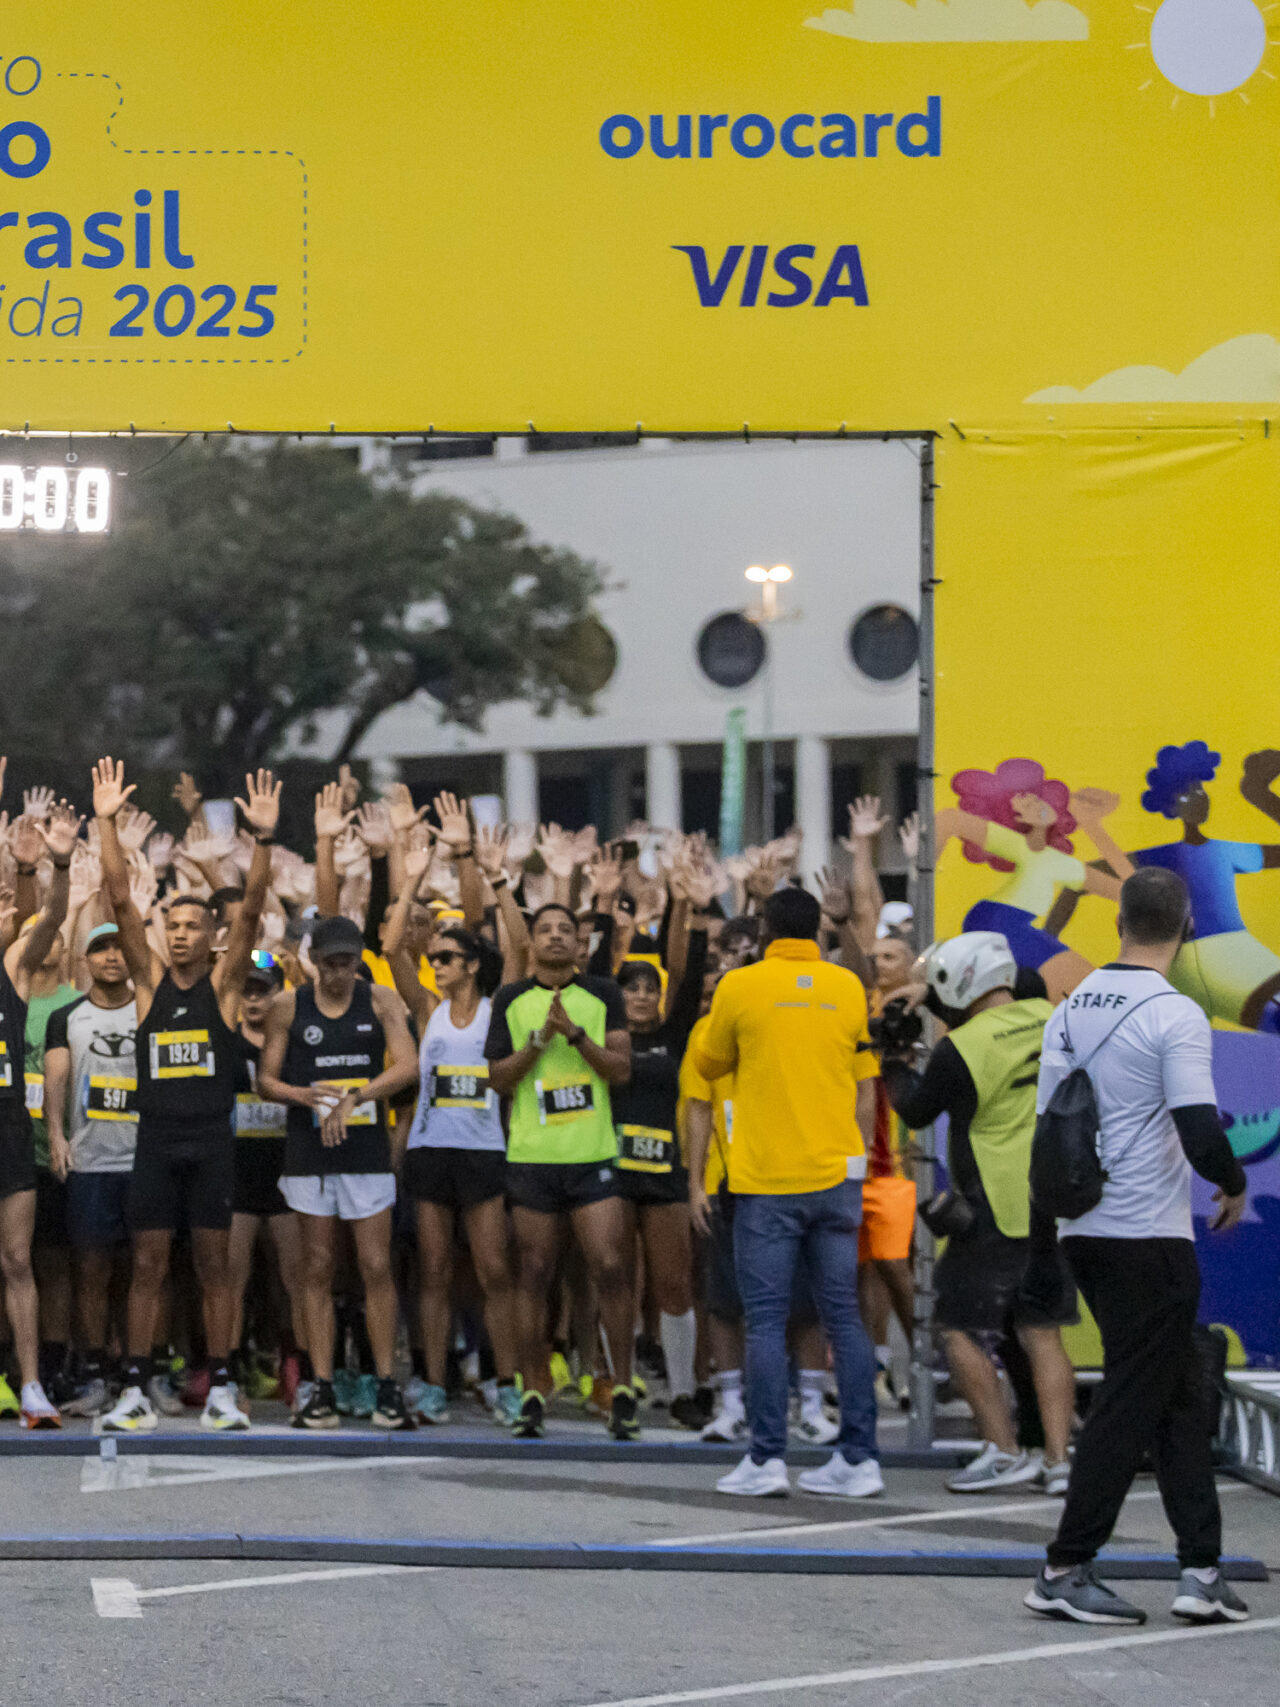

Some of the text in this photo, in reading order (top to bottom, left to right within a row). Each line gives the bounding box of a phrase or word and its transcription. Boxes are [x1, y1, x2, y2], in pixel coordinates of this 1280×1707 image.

[599, 95, 941, 159] ourocard
[670, 244, 870, 308] VISA
[108, 283, 278, 338] 2025
[1071, 992, 1127, 1009] STAFF
[168, 1042, 200, 1064] 1928
[103, 1088, 128, 1109] 591
